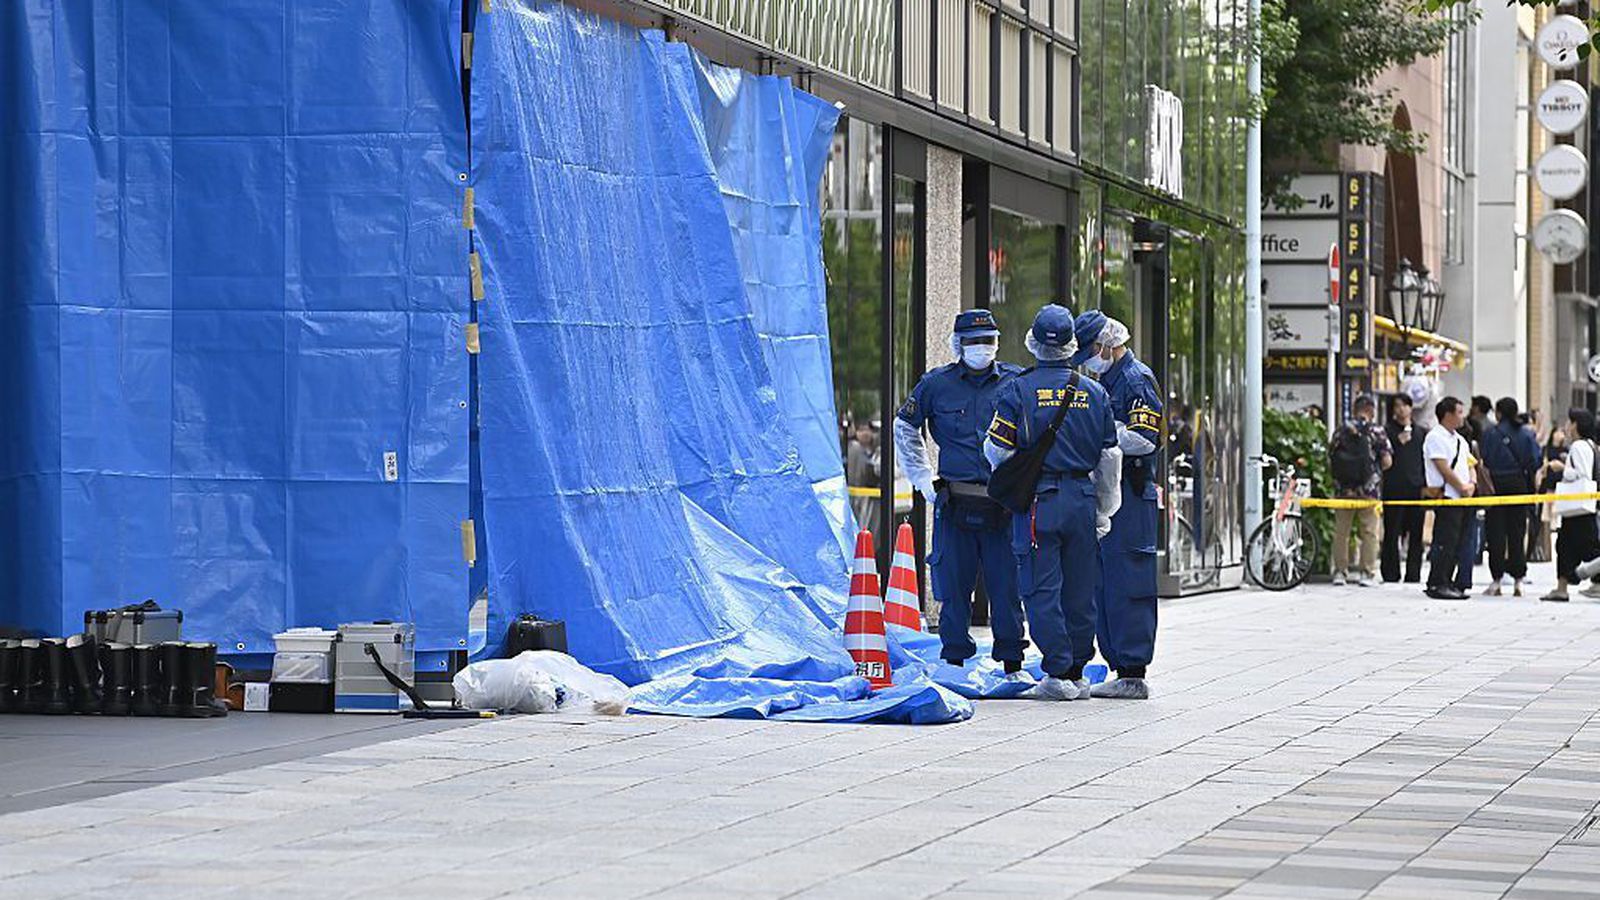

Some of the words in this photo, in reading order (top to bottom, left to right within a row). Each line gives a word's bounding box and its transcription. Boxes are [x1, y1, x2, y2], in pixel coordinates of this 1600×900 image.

[1349, 178, 1360, 211] 6F
[1349, 223, 1359, 255] 5F
[1348, 267, 1359, 300] 4F
[1348, 313, 1359, 346] 3F
